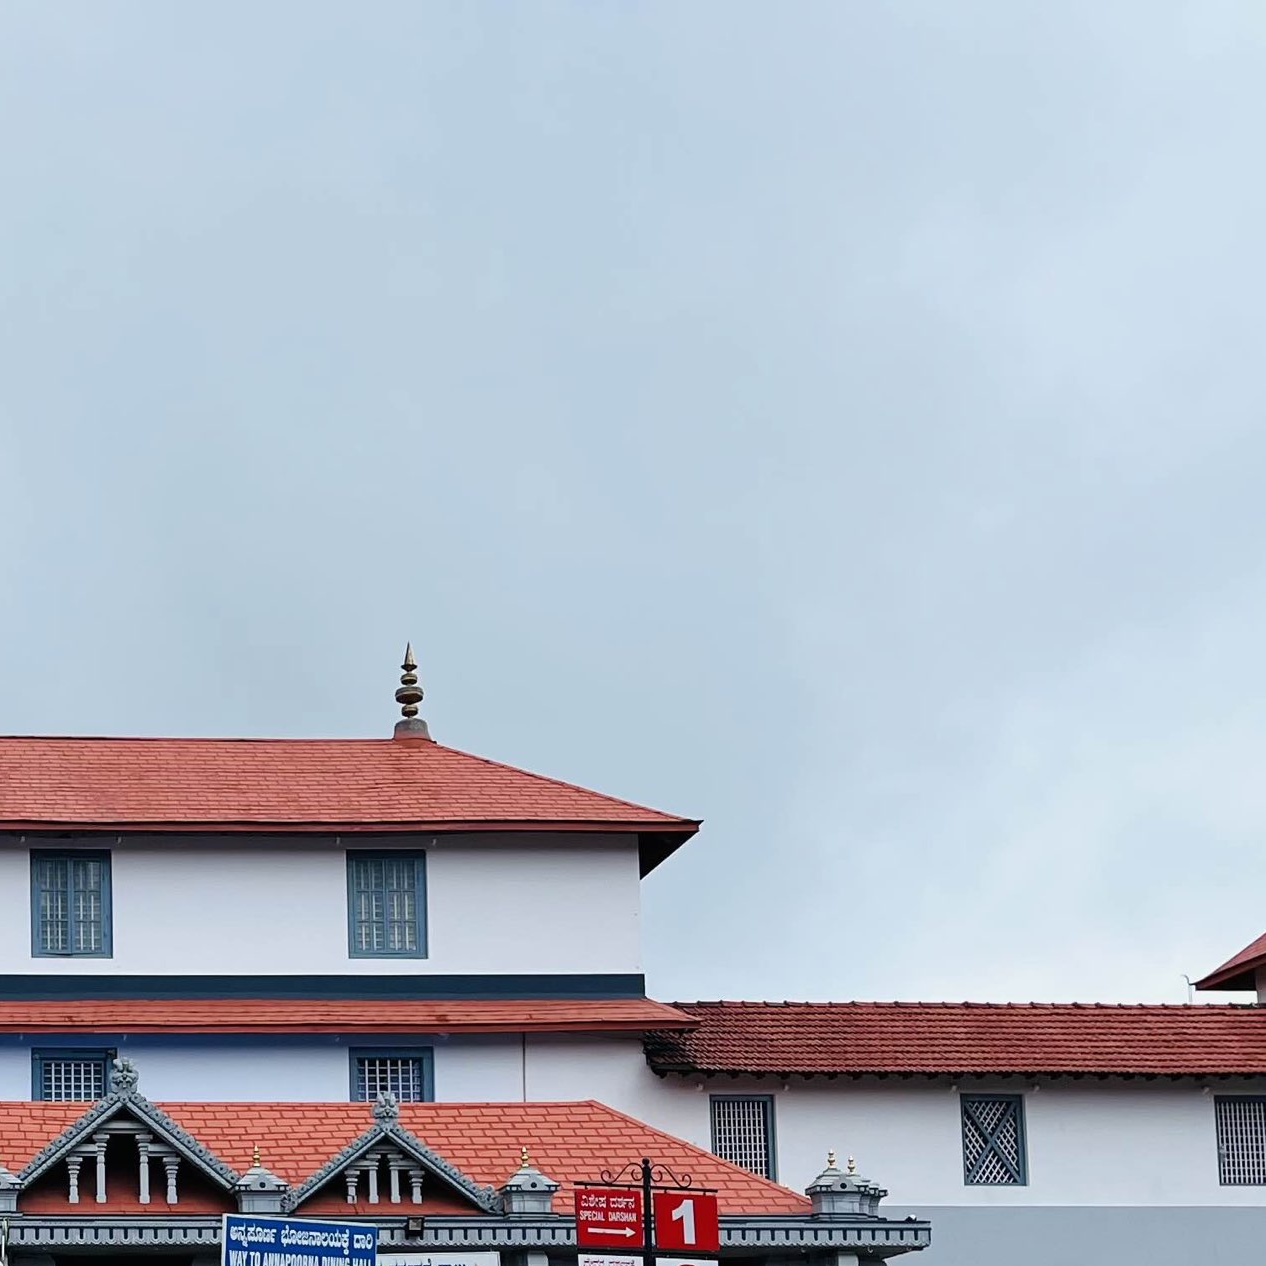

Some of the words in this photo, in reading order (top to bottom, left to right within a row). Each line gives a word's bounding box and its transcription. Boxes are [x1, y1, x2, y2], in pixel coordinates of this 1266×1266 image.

[579, 1210, 605, 1221] SPECIAL
[608, 1211, 637, 1222] DARSHAN
[671, 1199, 696, 1245] 1
[353, 1233, 373, 1250] ದಾರಿ
